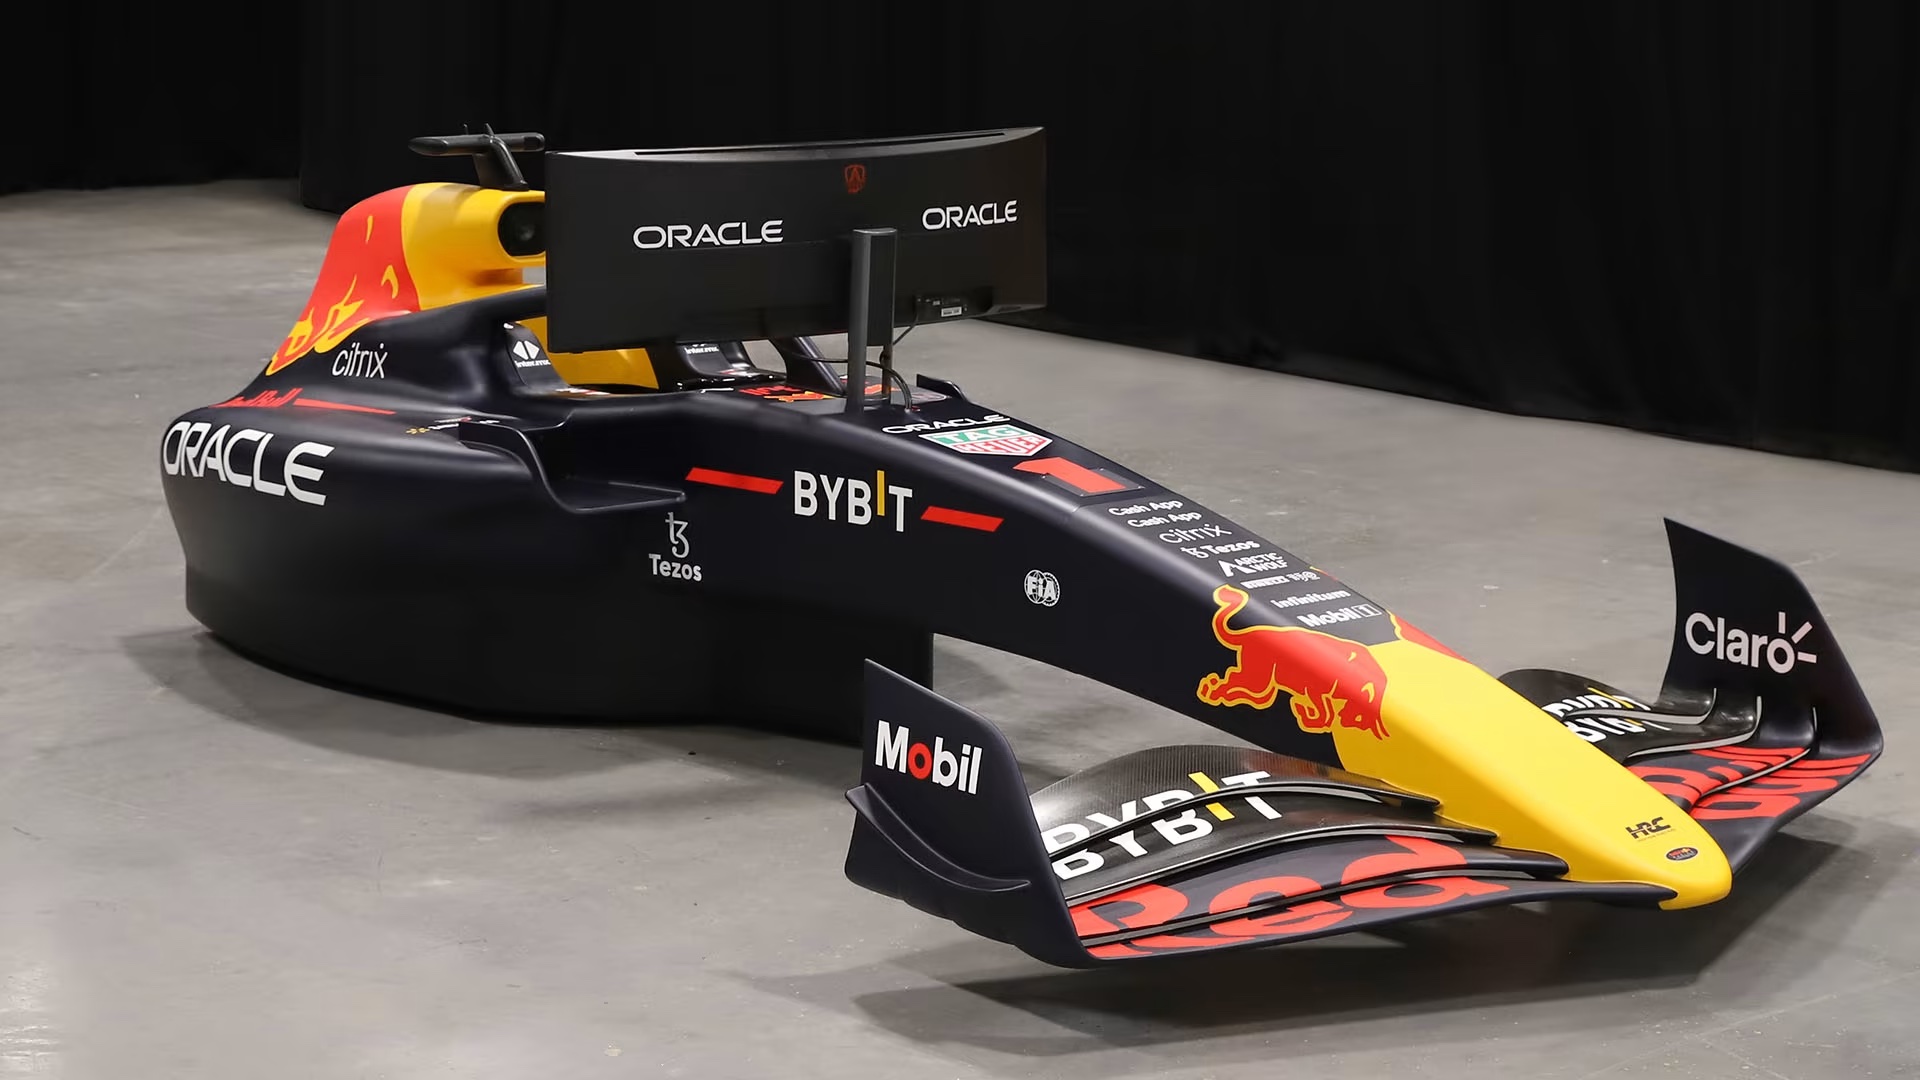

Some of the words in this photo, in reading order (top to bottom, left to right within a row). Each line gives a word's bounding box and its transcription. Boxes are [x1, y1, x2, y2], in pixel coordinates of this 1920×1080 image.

[922, 200, 1018, 230] ORACLE
[631, 220, 784, 249] ORACLE
[332, 343, 389, 378] citrix
[882, 414, 1011, 434] ORACLE
[944, 427, 1015, 443] TAG
[958, 436, 1043, 455] HEUER
[163, 421, 335, 506] ORACLE
[1013, 457, 1125, 493] 1
[793, 470, 912, 532] BYBIT
[1109, 504, 1151, 516] Cash
[1149, 499, 1183, 511] App
[1127, 516, 1169, 527] Cash
[1167, 511, 1202, 523] App
[1200, 540, 1260, 555] Tezos
[1234, 552, 1283, 566] ARCTIC
[649, 554, 702, 581] Tezos
[1249, 560, 1288, 572] WOLF
[1685, 611, 1817, 674] Claro
[875, 720, 982, 795] Mobil
